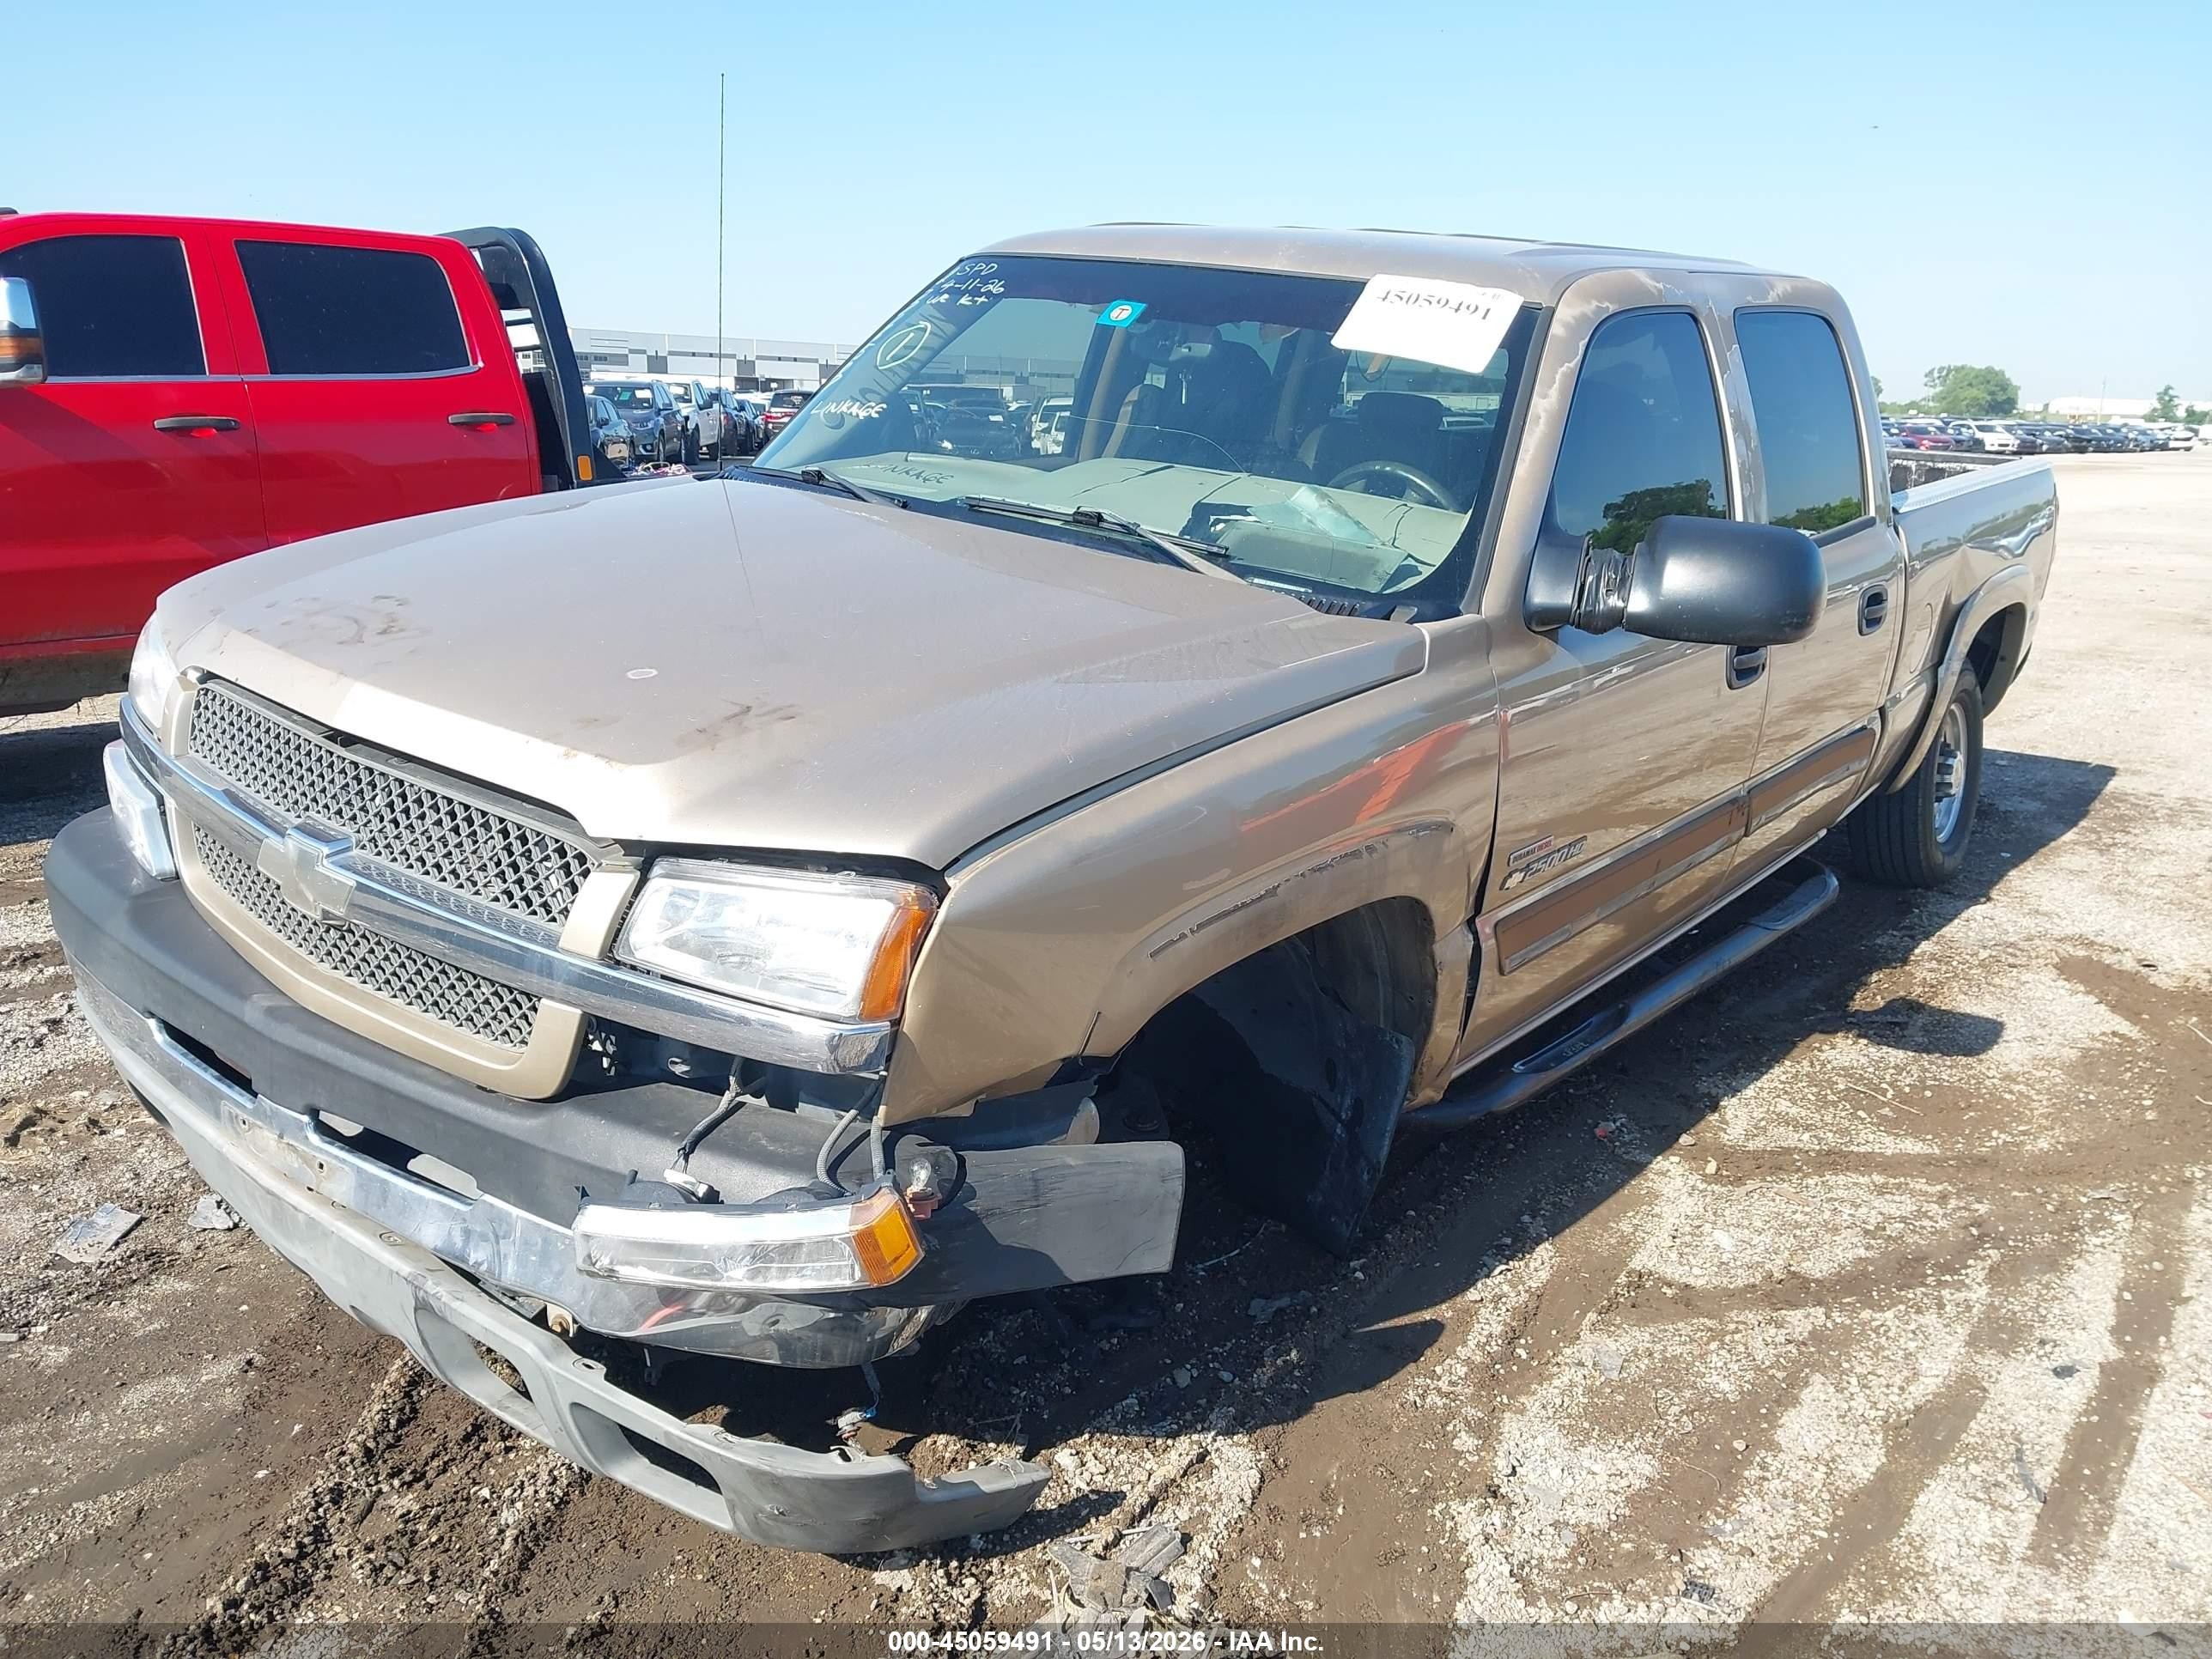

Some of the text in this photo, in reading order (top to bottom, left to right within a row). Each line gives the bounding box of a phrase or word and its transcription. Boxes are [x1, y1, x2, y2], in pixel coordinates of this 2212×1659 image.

[1115, 307, 1129, 319] T
[1376, 289, 1492, 321] 45059491
[811, 398, 888, 420] LINKAGE
